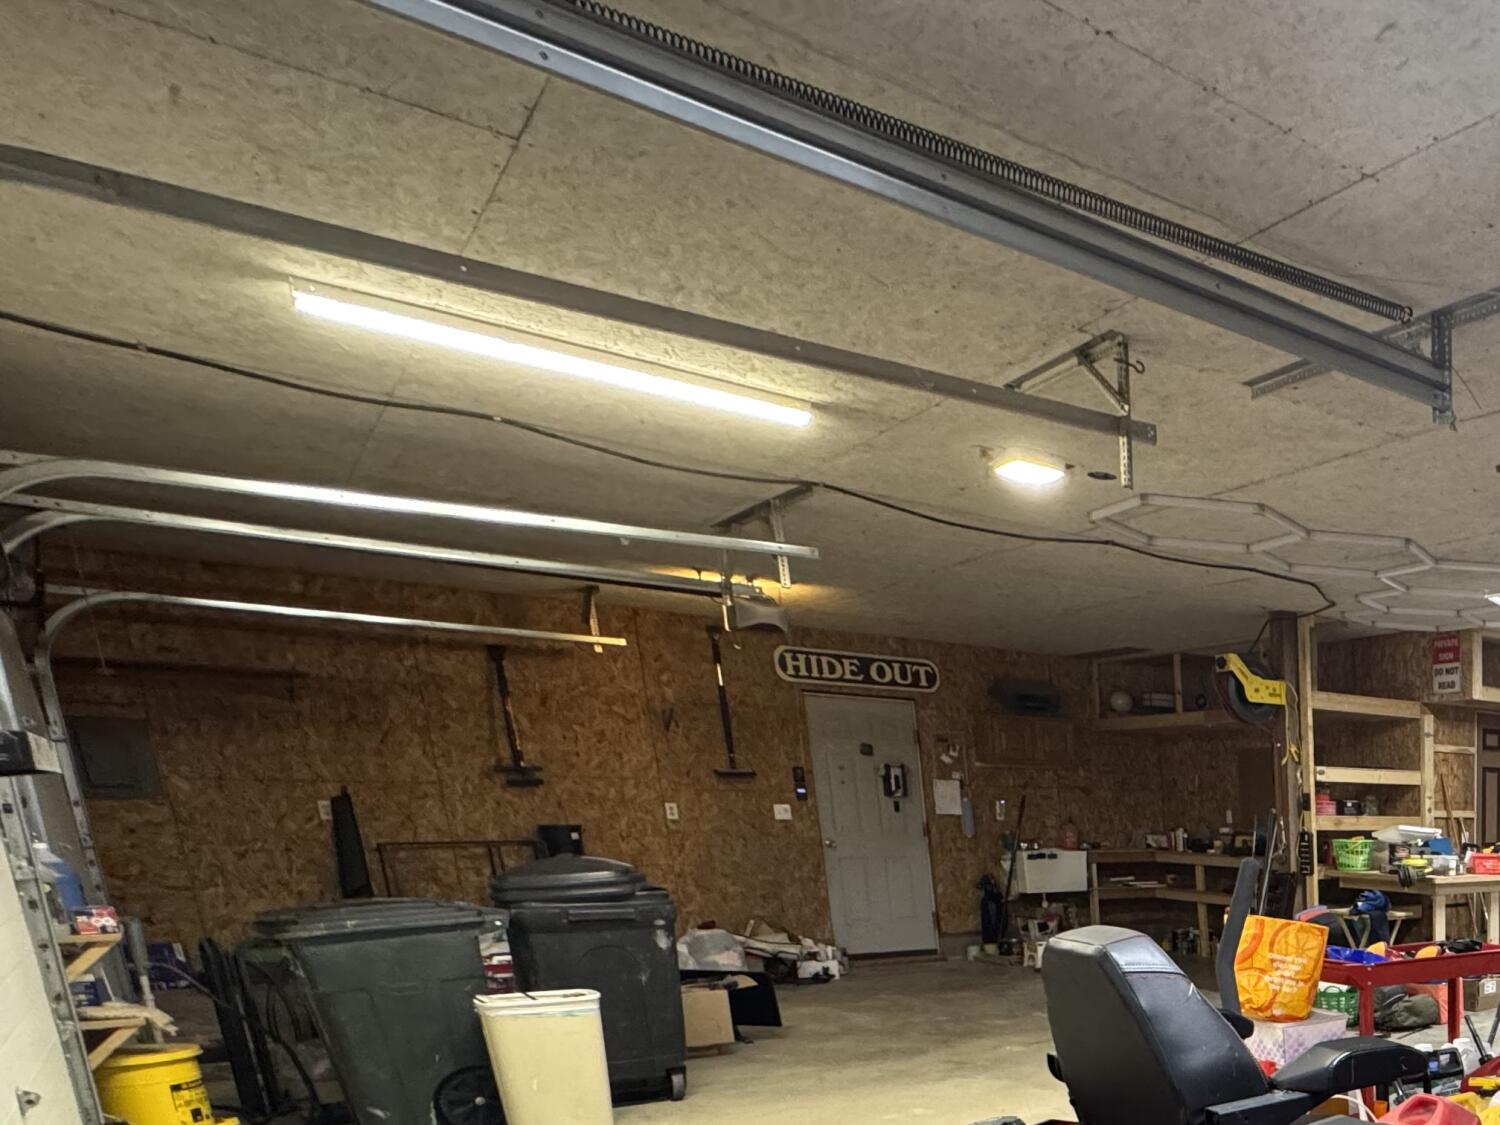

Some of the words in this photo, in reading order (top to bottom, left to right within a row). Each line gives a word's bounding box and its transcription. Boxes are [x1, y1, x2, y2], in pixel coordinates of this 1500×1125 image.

[783, 652, 864, 681] HIDE
[869, 661, 934, 687] OUT
[1434, 668, 1444, 677] DO
[1445, 666, 1459, 676] NOT
[1438, 680, 1456, 690] READ
